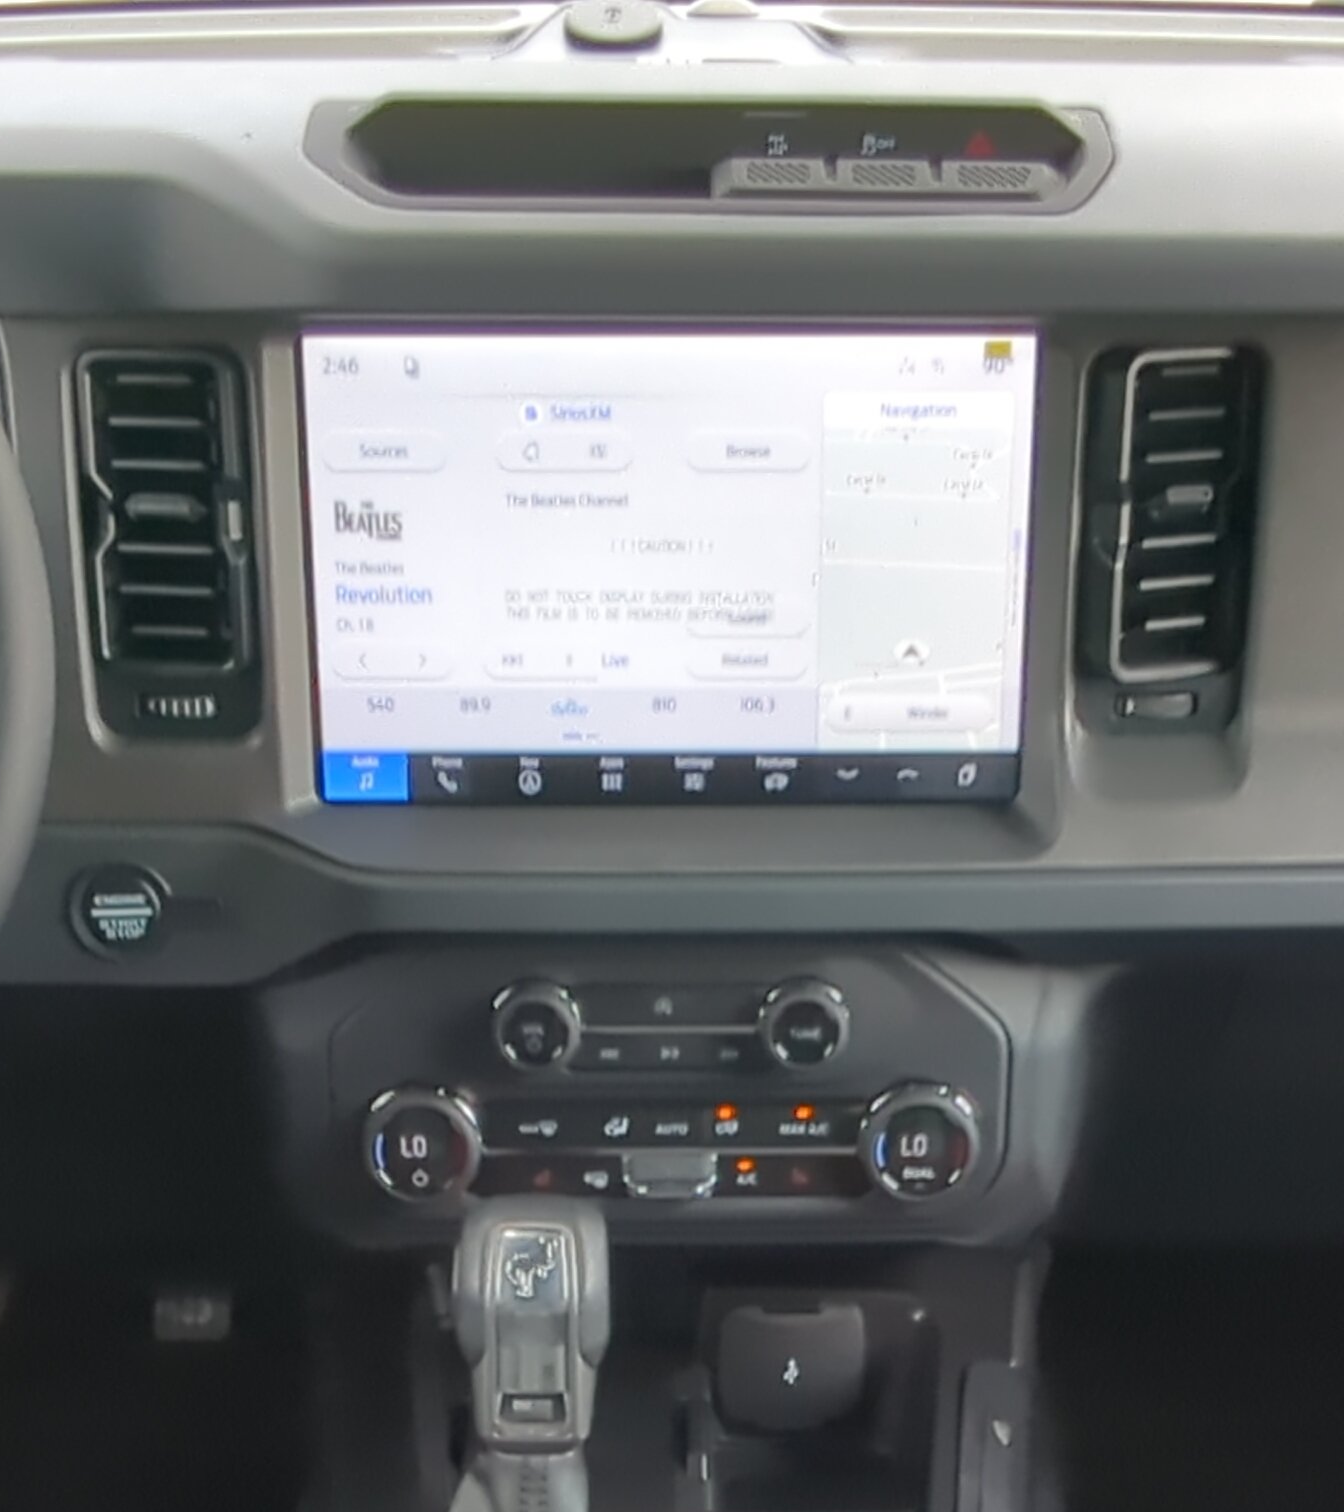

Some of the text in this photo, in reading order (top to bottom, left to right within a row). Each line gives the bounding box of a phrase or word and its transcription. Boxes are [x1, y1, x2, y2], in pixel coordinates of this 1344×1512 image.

[323, 356, 359, 376] 2:46
[880, 403, 957, 421] Navigation
[359, 443, 408, 459] Sources
[725, 444, 772, 459] Browse
[506, 493, 629, 508] The Beatles Channel
[335, 561, 404, 575] The Beatles
[335, 584, 433, 605] Revolution
[601, 653, 630, 668] Live
[367, 696, 395, 713] 540
[460, 696, 492, 713] 89.9
[432, 757, 463, 769] Phone
[655, 1122, 689, 1136] AUTO
[399, 1135, 428, 1159] LO
[900, 1133, 929, 1157] LO
